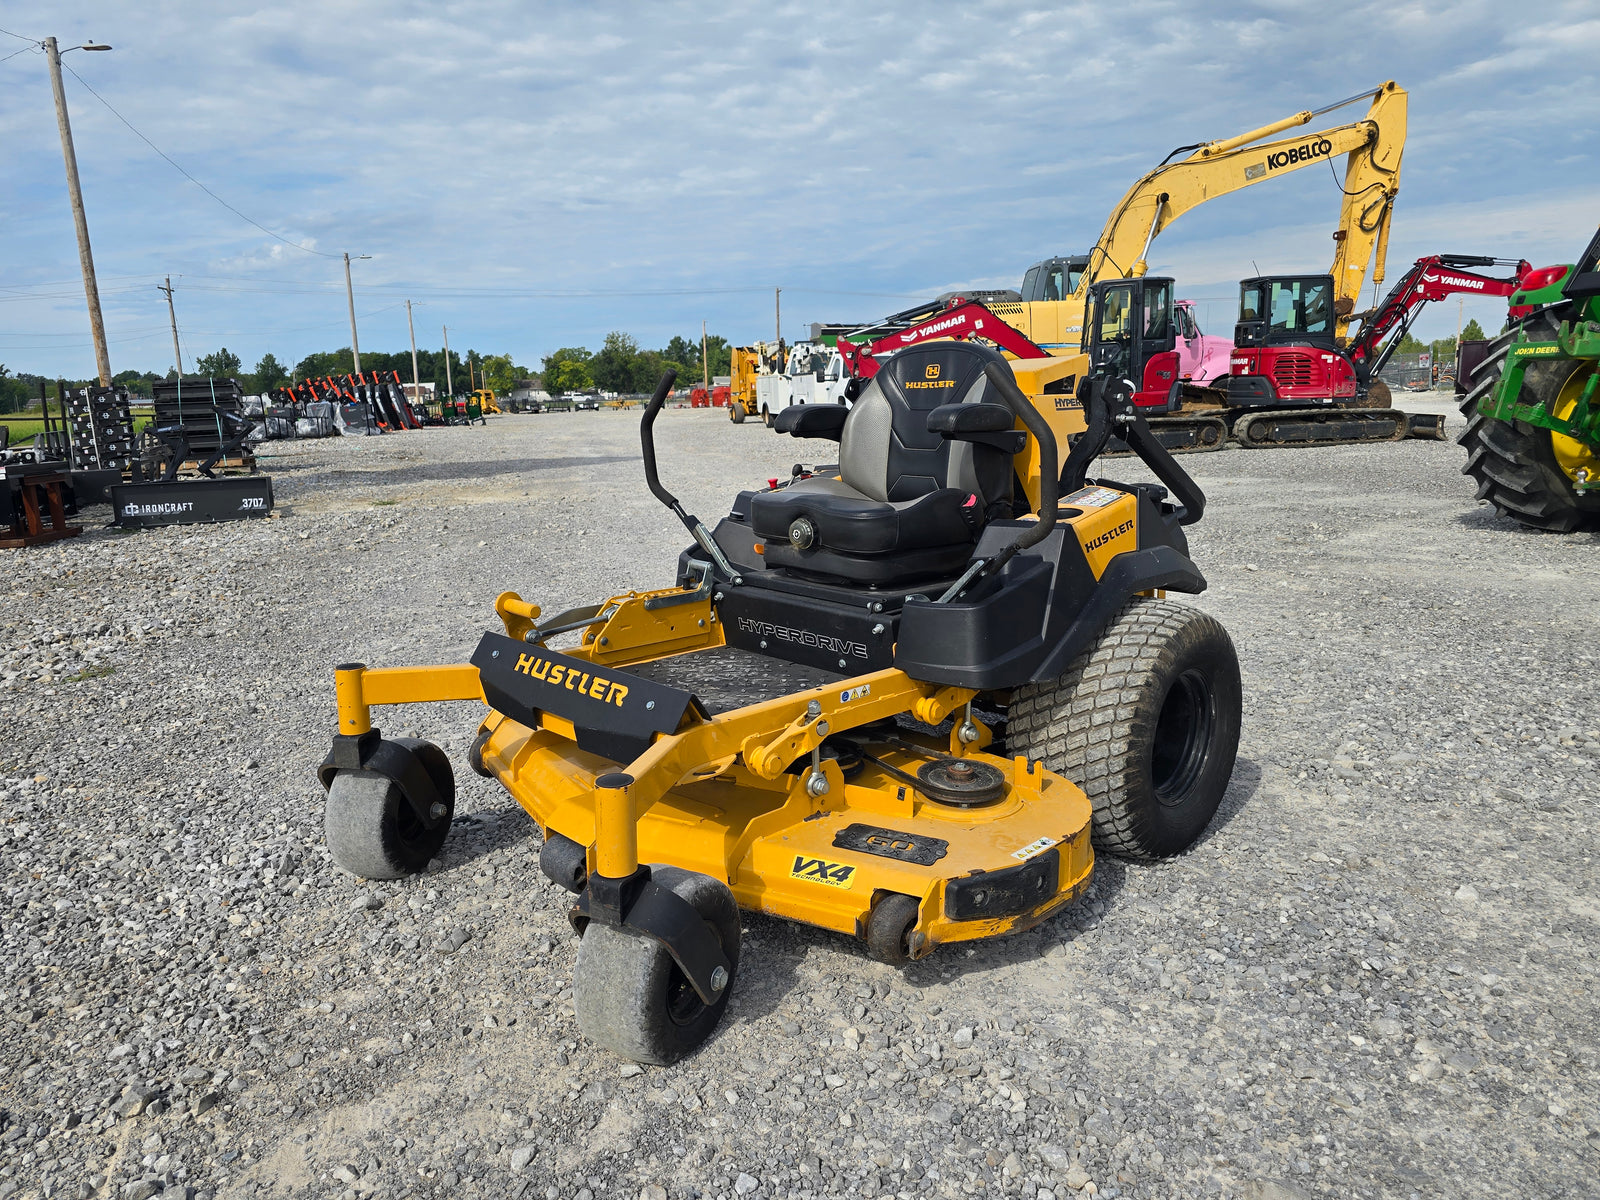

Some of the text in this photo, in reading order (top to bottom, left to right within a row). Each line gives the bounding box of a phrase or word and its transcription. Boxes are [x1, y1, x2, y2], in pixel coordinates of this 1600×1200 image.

[1267, 139, 1332, 170] KOBELCO
[1440, 275, 1485, 289] YANMAR
[918, 314, 966, 337] YANMAR
[1514, 347, 1535, 355] JOHN
[905, 380, 955, 389] HUSTLER
[142, 497, 264, 513] IRONCRAFT 3707
[1084, 519, 1134, 553] HUSTLER
[737, 616, 868, 659] HYPERDRIVE
[513, 652, 629, 707] HUSTLER
[791, 873, 842, 886] TECHNOLOGY
[792, 856, 855, 882] VX4
